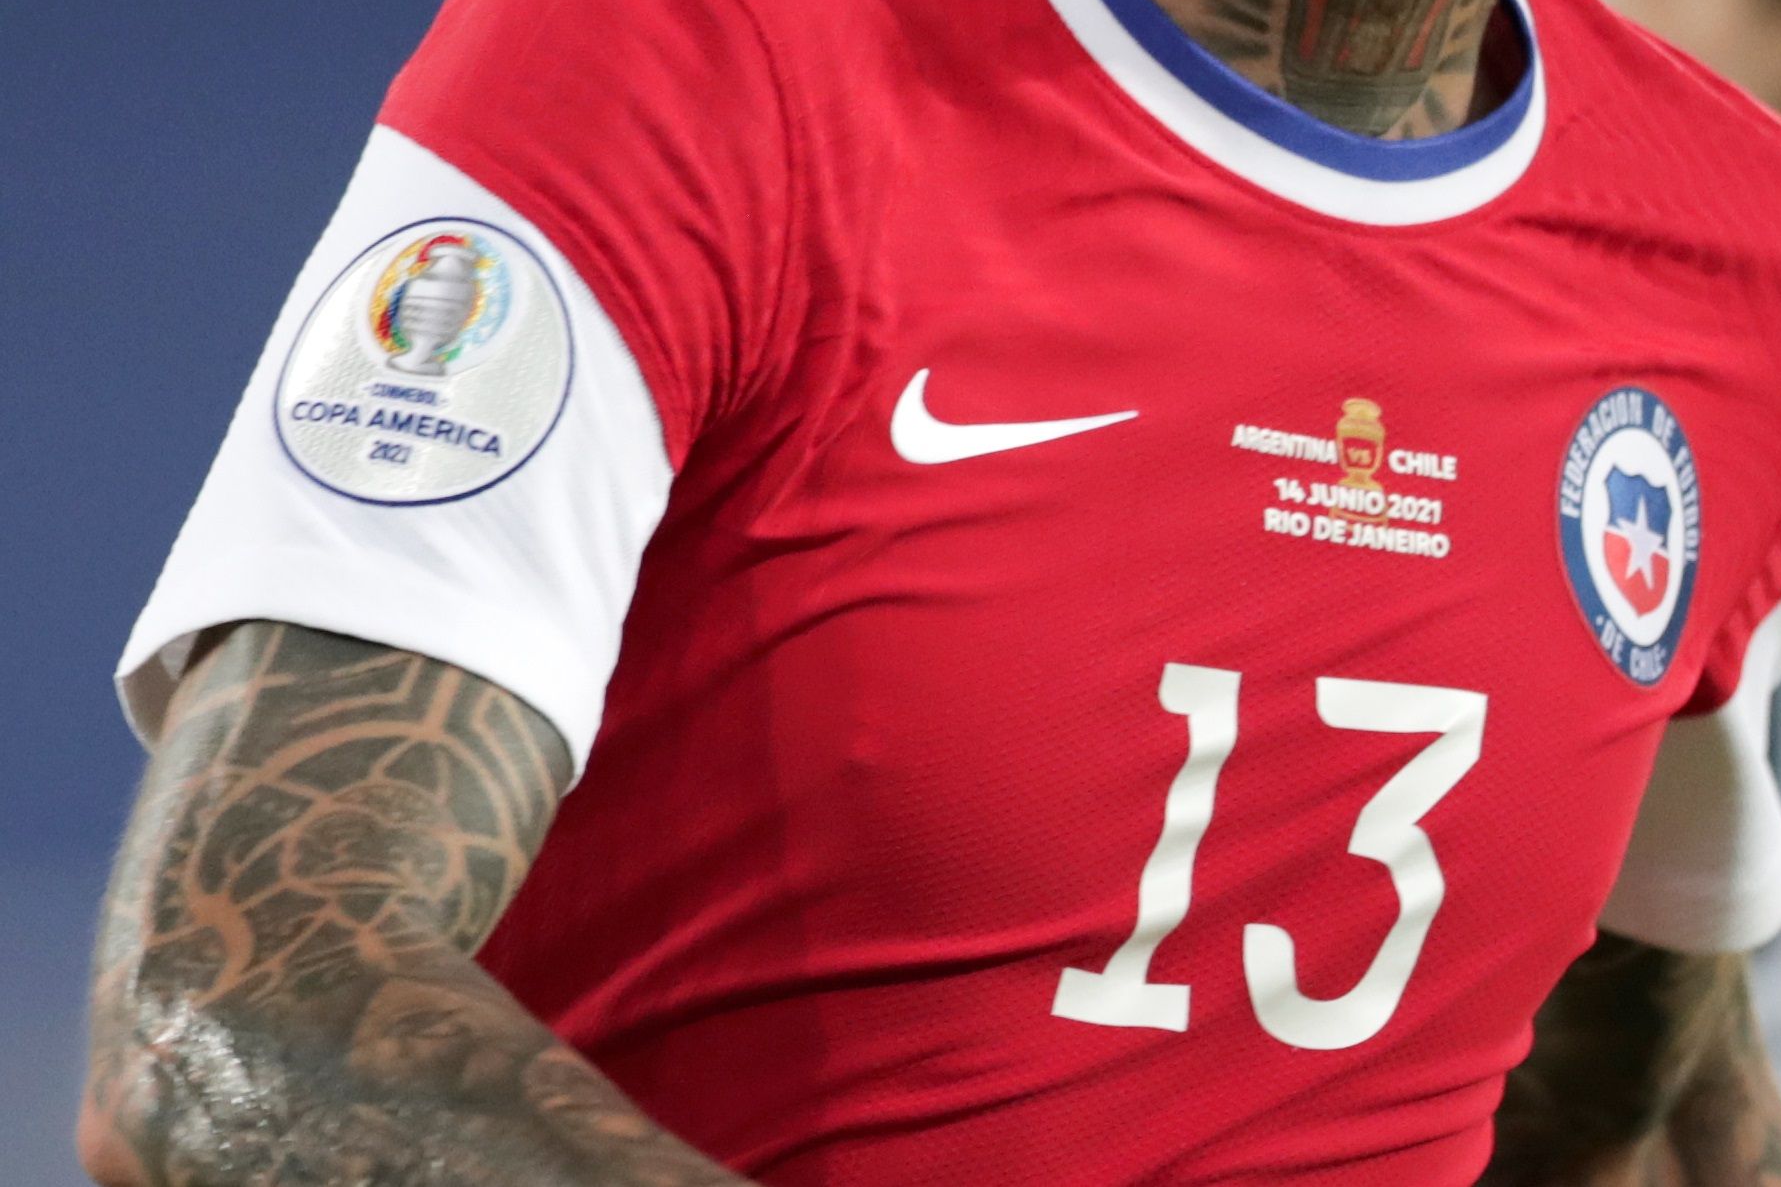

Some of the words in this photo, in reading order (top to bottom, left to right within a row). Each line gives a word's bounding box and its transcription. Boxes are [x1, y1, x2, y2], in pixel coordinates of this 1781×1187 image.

[291, 400, 362, 426] COPA
[366, 408, 502, 458] AMERICA
[1231, 424, 1338, 464] ARGENTINA
[1388, 449, 1458, 480] CHILE
[1652, 403, 1676, 450] DE
[1273, 477, 1306, 503] 14
[1306, 483, 1385, 516] JUNIO
[1386, 494, 1442, 525] 2021
[1263, 507, 1311, 537] RIO
[1312, 516, 1347, 543] DE
[1347, 523, 1450, 559] JANEIRO
[1600, 619, 1624, 664] DE
[1051, 662, 1488, 1050] 13
